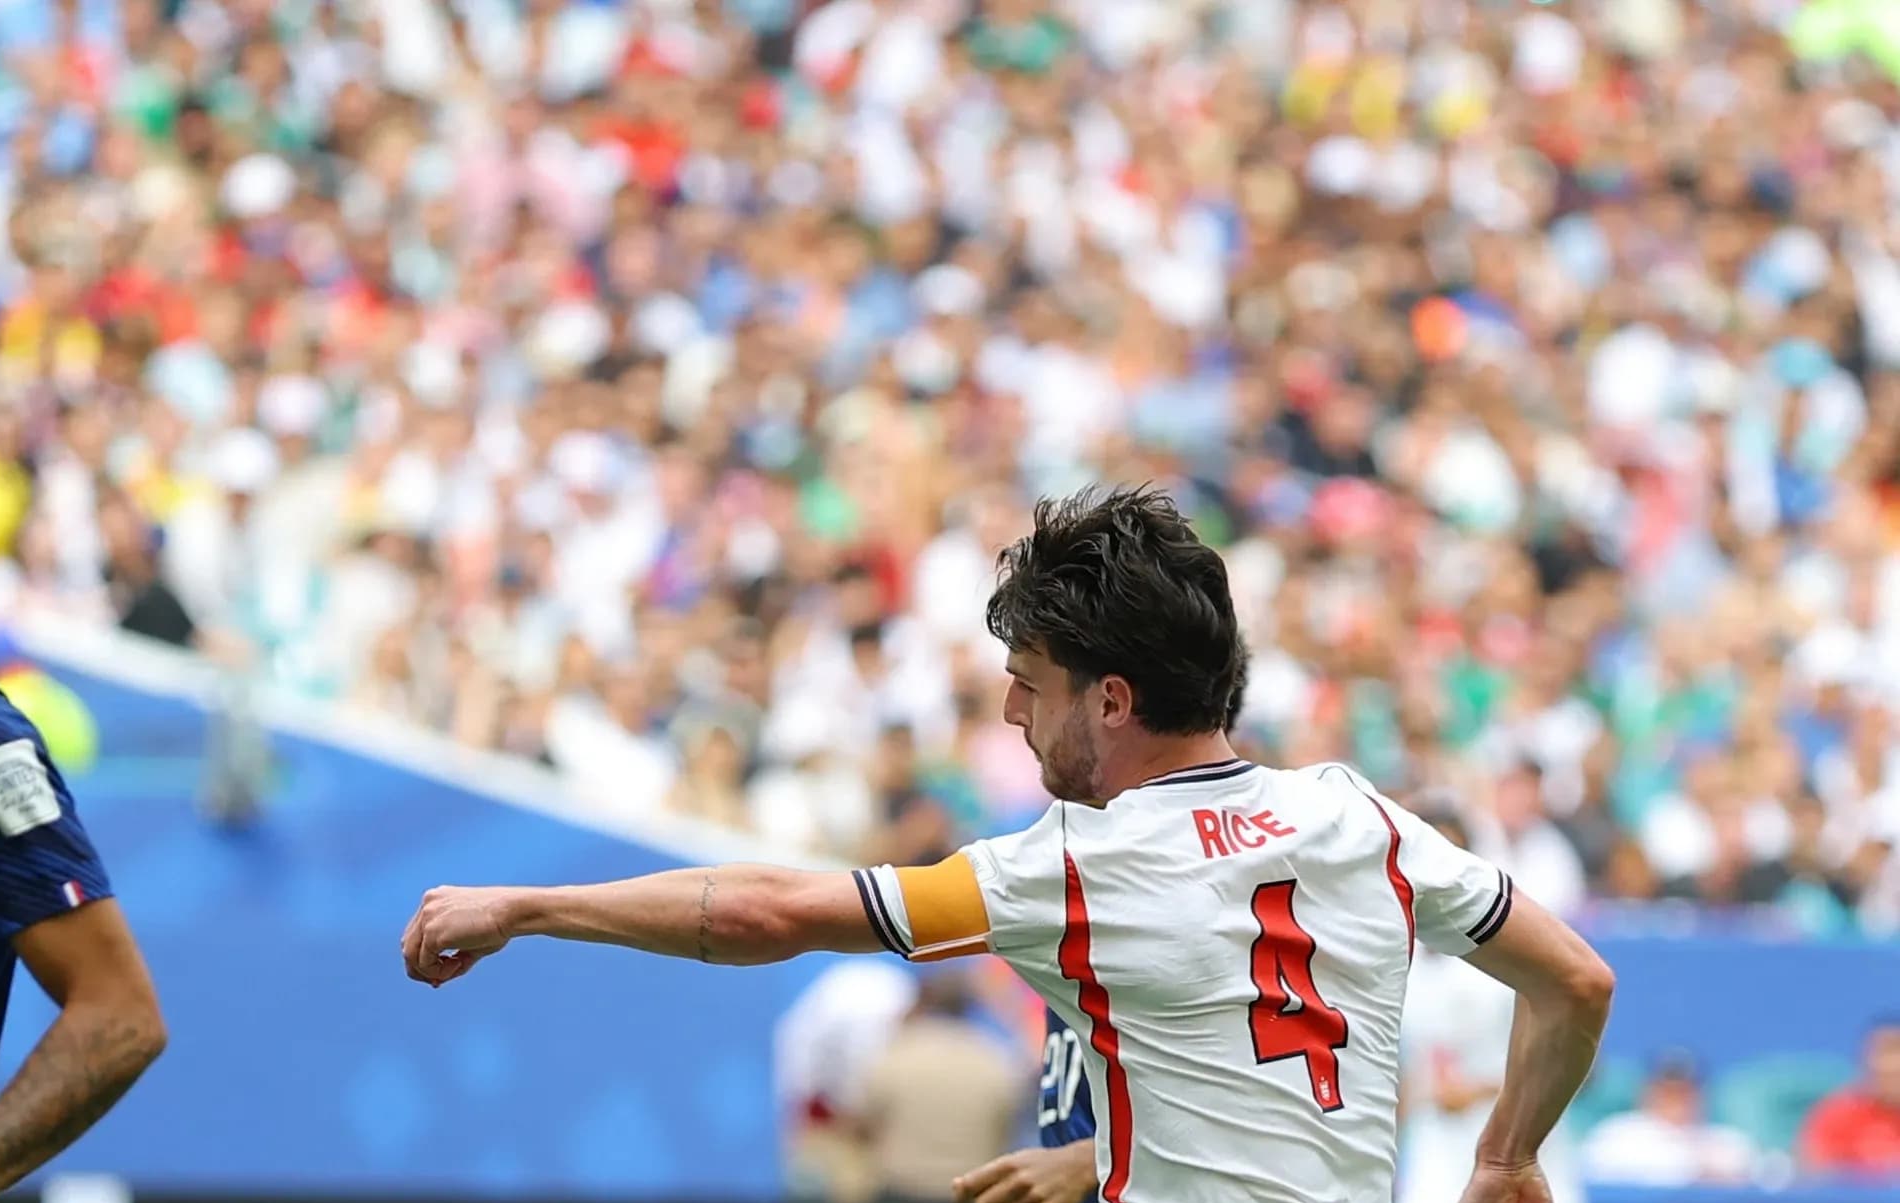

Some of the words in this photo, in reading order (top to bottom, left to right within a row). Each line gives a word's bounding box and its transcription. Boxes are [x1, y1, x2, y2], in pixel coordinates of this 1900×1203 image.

[1192, 809, 1297, 858] RICE
[1248, 879, 1348, 1113] 4
[1038, 1029, 1082, 1128] 20
